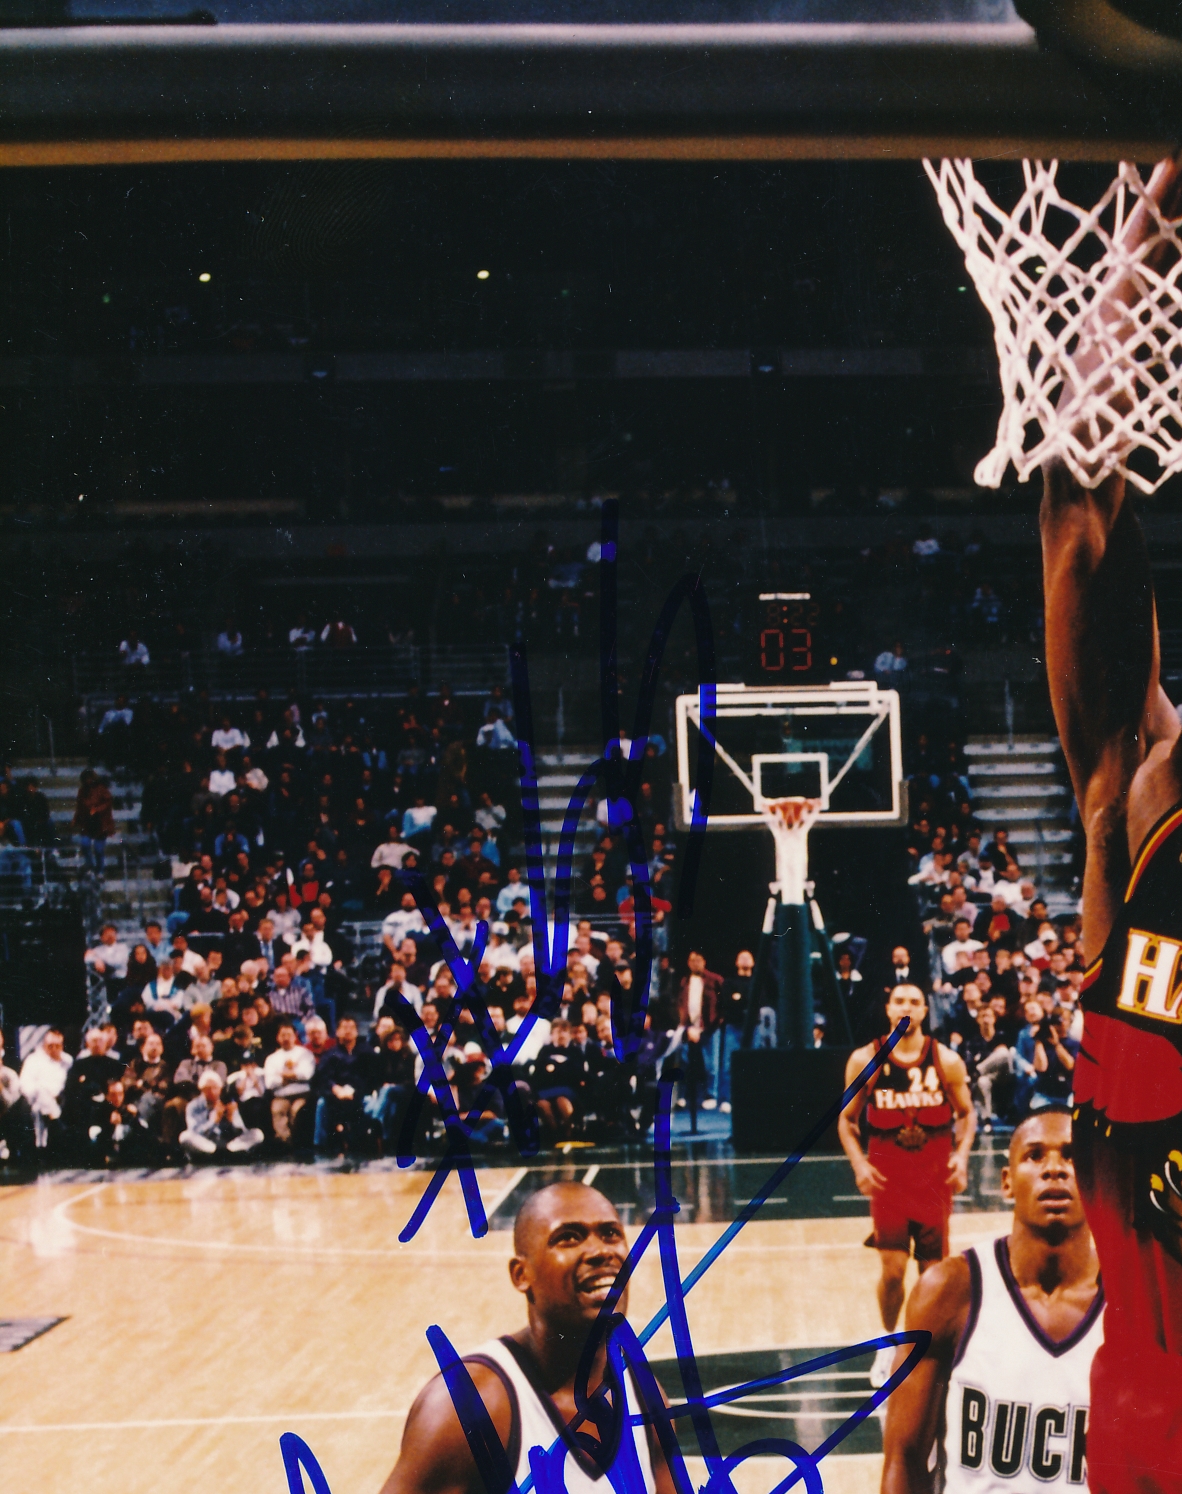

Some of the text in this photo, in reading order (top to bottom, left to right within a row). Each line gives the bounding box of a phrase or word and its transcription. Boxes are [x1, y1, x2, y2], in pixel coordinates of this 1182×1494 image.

[760, 628, 812, 672] 03
[907, 1065, 940, 1093] 24
[874, 1088, 944, 1109] HAWKS
